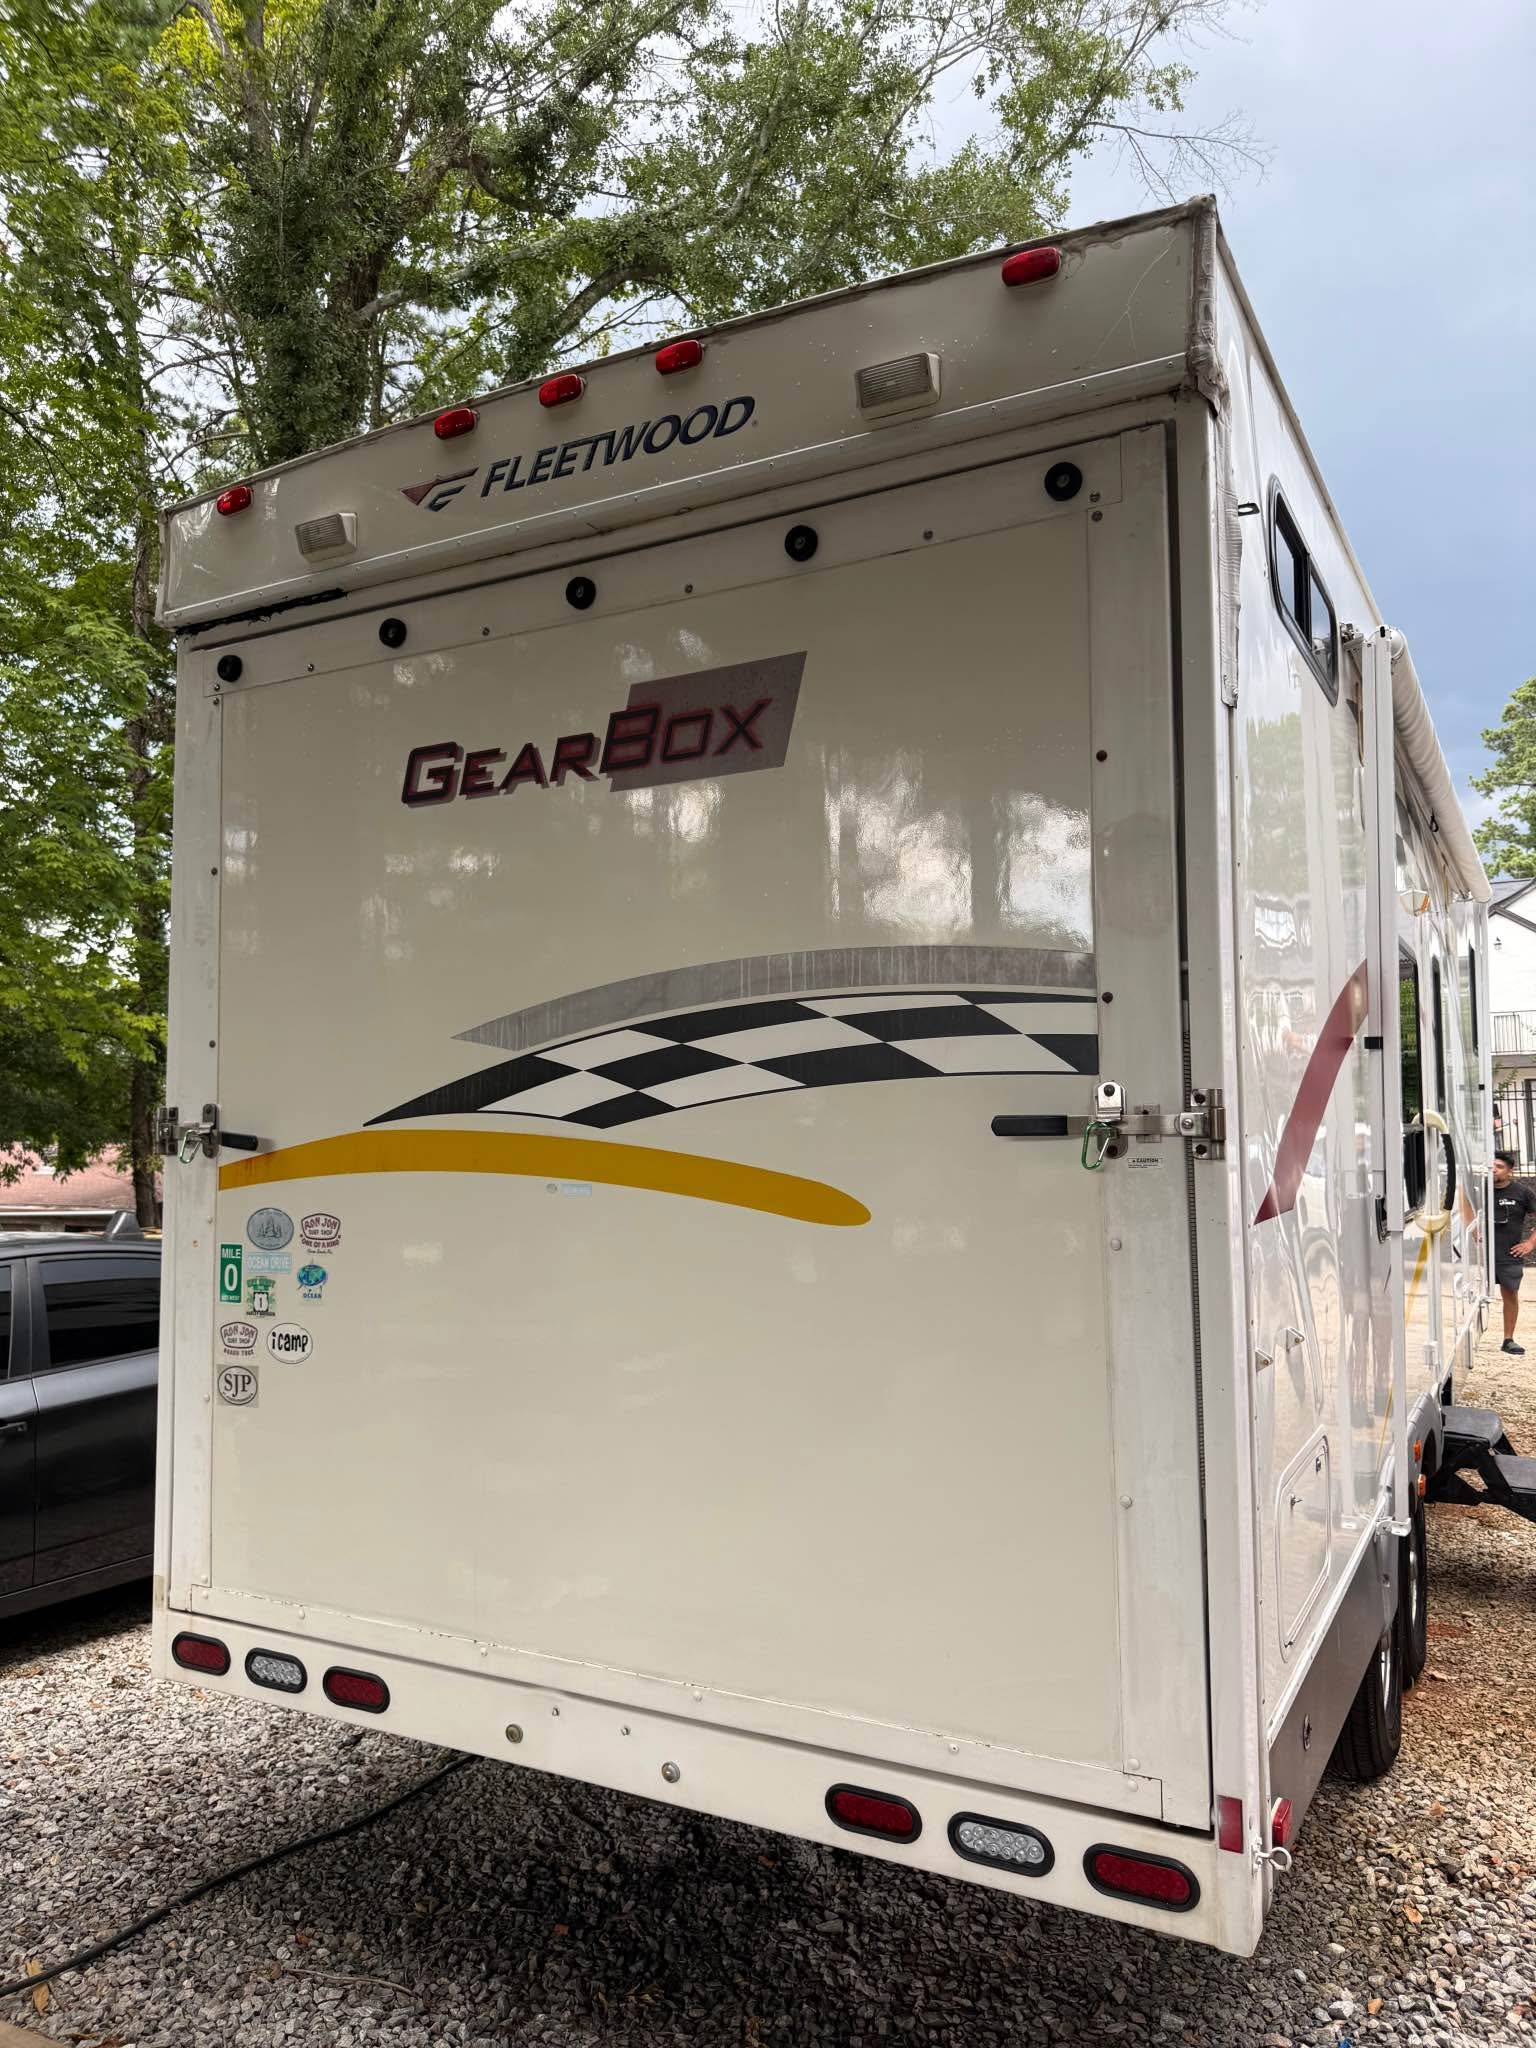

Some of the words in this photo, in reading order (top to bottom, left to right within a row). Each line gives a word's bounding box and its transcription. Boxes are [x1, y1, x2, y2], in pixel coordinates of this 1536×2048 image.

[480, 396, 755, 498] FLEETWOOD
[304, 1217, 321, 1230] RON
[322, 1218, 338, 1230] JON
[221, 1247, 241, 1259] MILE
[224, 1263, 238, 1291] 0
[223, 1325, 239, 1338] RON
[239, 1326, 255, 1338] JON
[277, 1333, 308, 1352] camp
[223, 1373, 252, 1397] SJP
